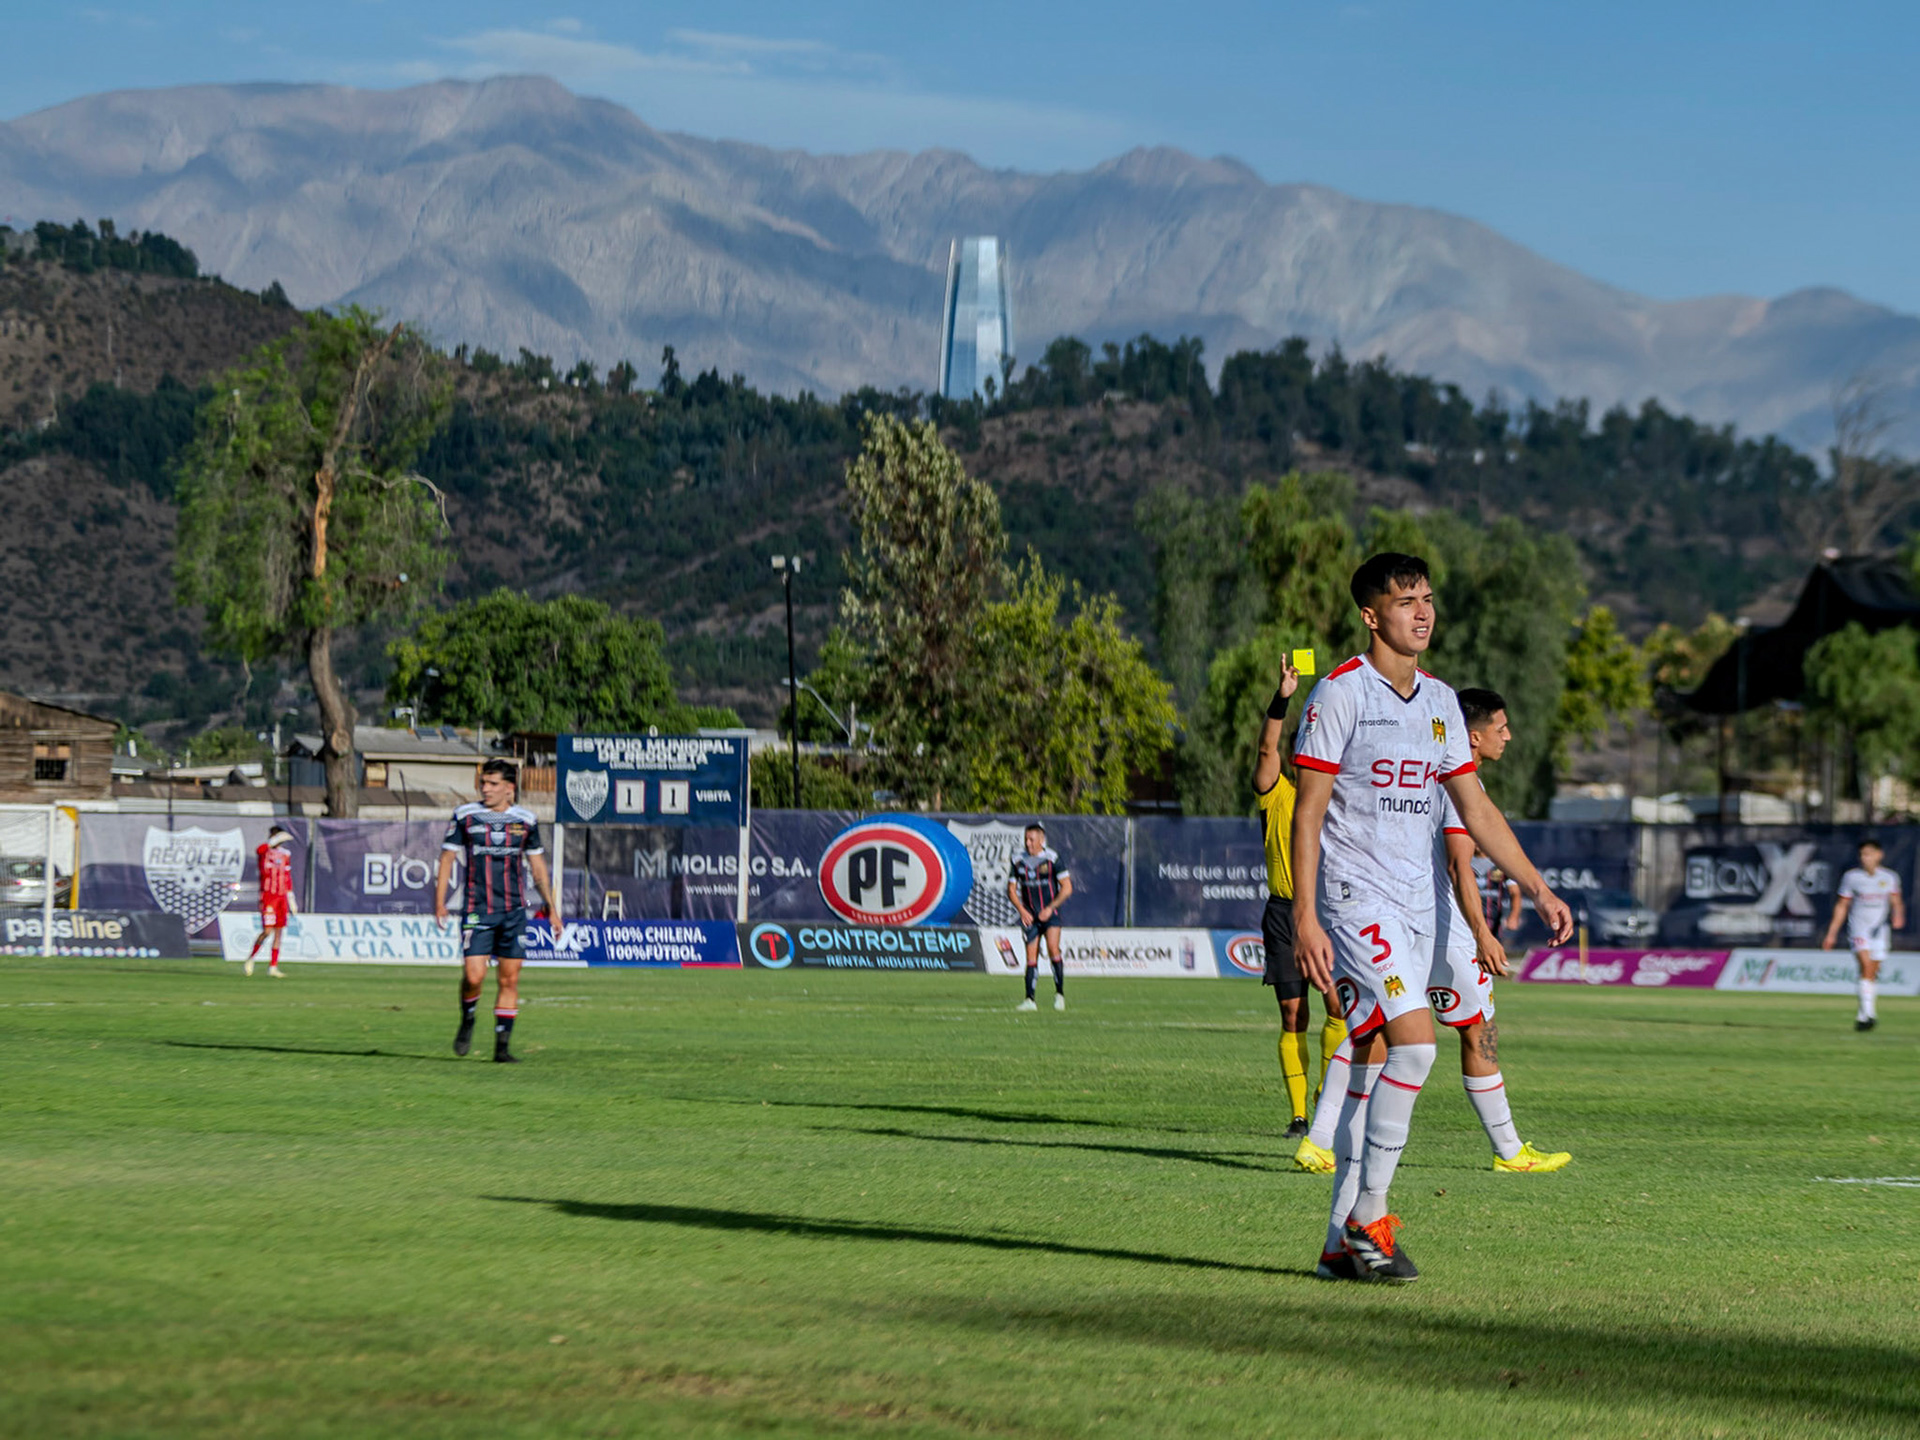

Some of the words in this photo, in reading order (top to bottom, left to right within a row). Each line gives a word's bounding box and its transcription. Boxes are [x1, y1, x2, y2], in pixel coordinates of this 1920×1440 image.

[1358, 718, 1399, 727] marathon
[572, 737, 642, 753] ESTADIO
[646, 738, 735, 754] MUNICIPAL
[625, 788, 634, 807] 1
[670, 788, 678, 807] 1
[695, 789, 732, 802] VISITA
[149, 846, 240, 866] RECOLETA
[671, 854, 767, 876] MOLISC
[849, 847, 909, 909] PF
[1193, 865, 1224, 882] que
[1227, 866, 1247, 880] un
[1202, 884, 1255, 900] somos
[325, 919, 393, 937] ELIAS
[401, 920, 462, 938] MAZ
[604, 926, 643, 943] 100%
[328, 939, 342, 957] Y
[352, 940, 403, 959] CIA.
[799, 928, 971, 953] CONTROLTEMP
[1359, 923, 1392, 964] 3
[826, 954, 874, 969] RENTAL
[877, 955, 950, 971] INDUSTRIAL
[1429, 991, 1450, 1009] PF
